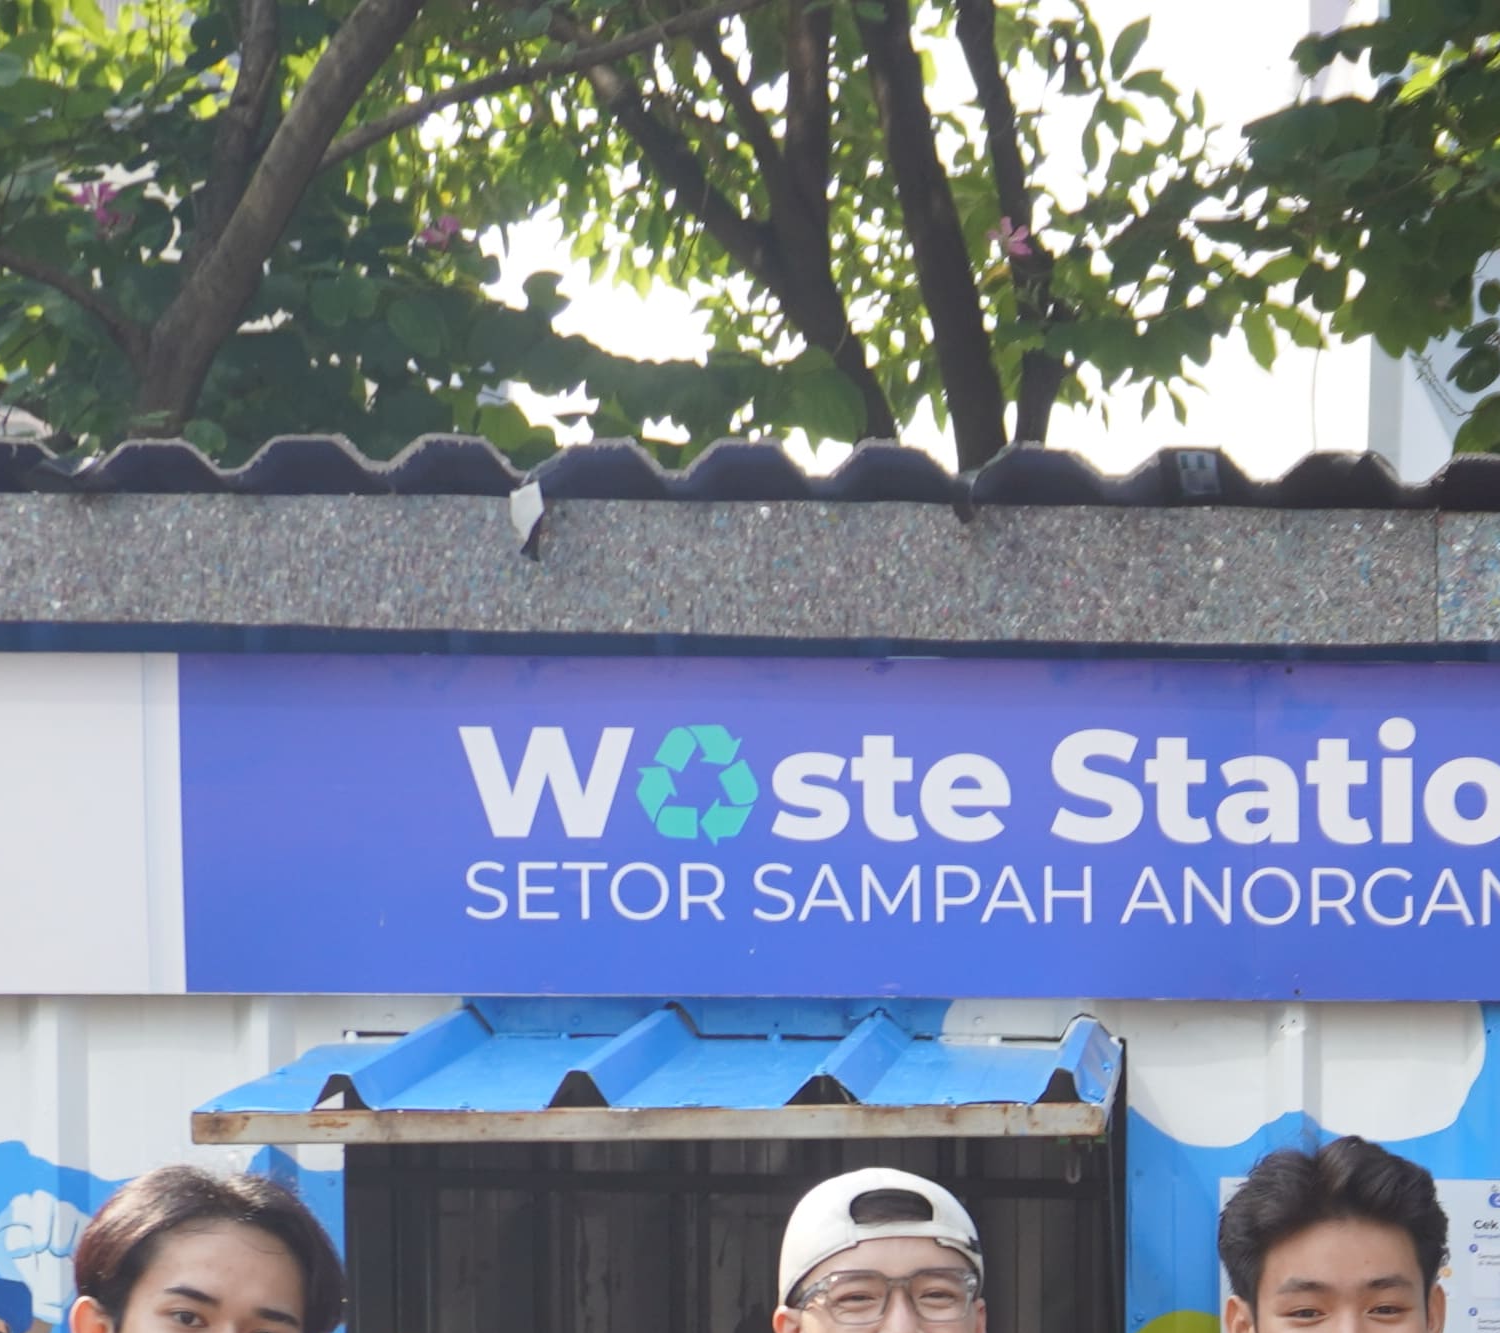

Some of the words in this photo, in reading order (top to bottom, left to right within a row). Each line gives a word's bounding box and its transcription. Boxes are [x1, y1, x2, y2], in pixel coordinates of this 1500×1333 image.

[464, 861, 726, 924] SETOR
[751, 864, 1095, 928] SAMPAH
[1473, 1220, 1498, 1230] Cek
